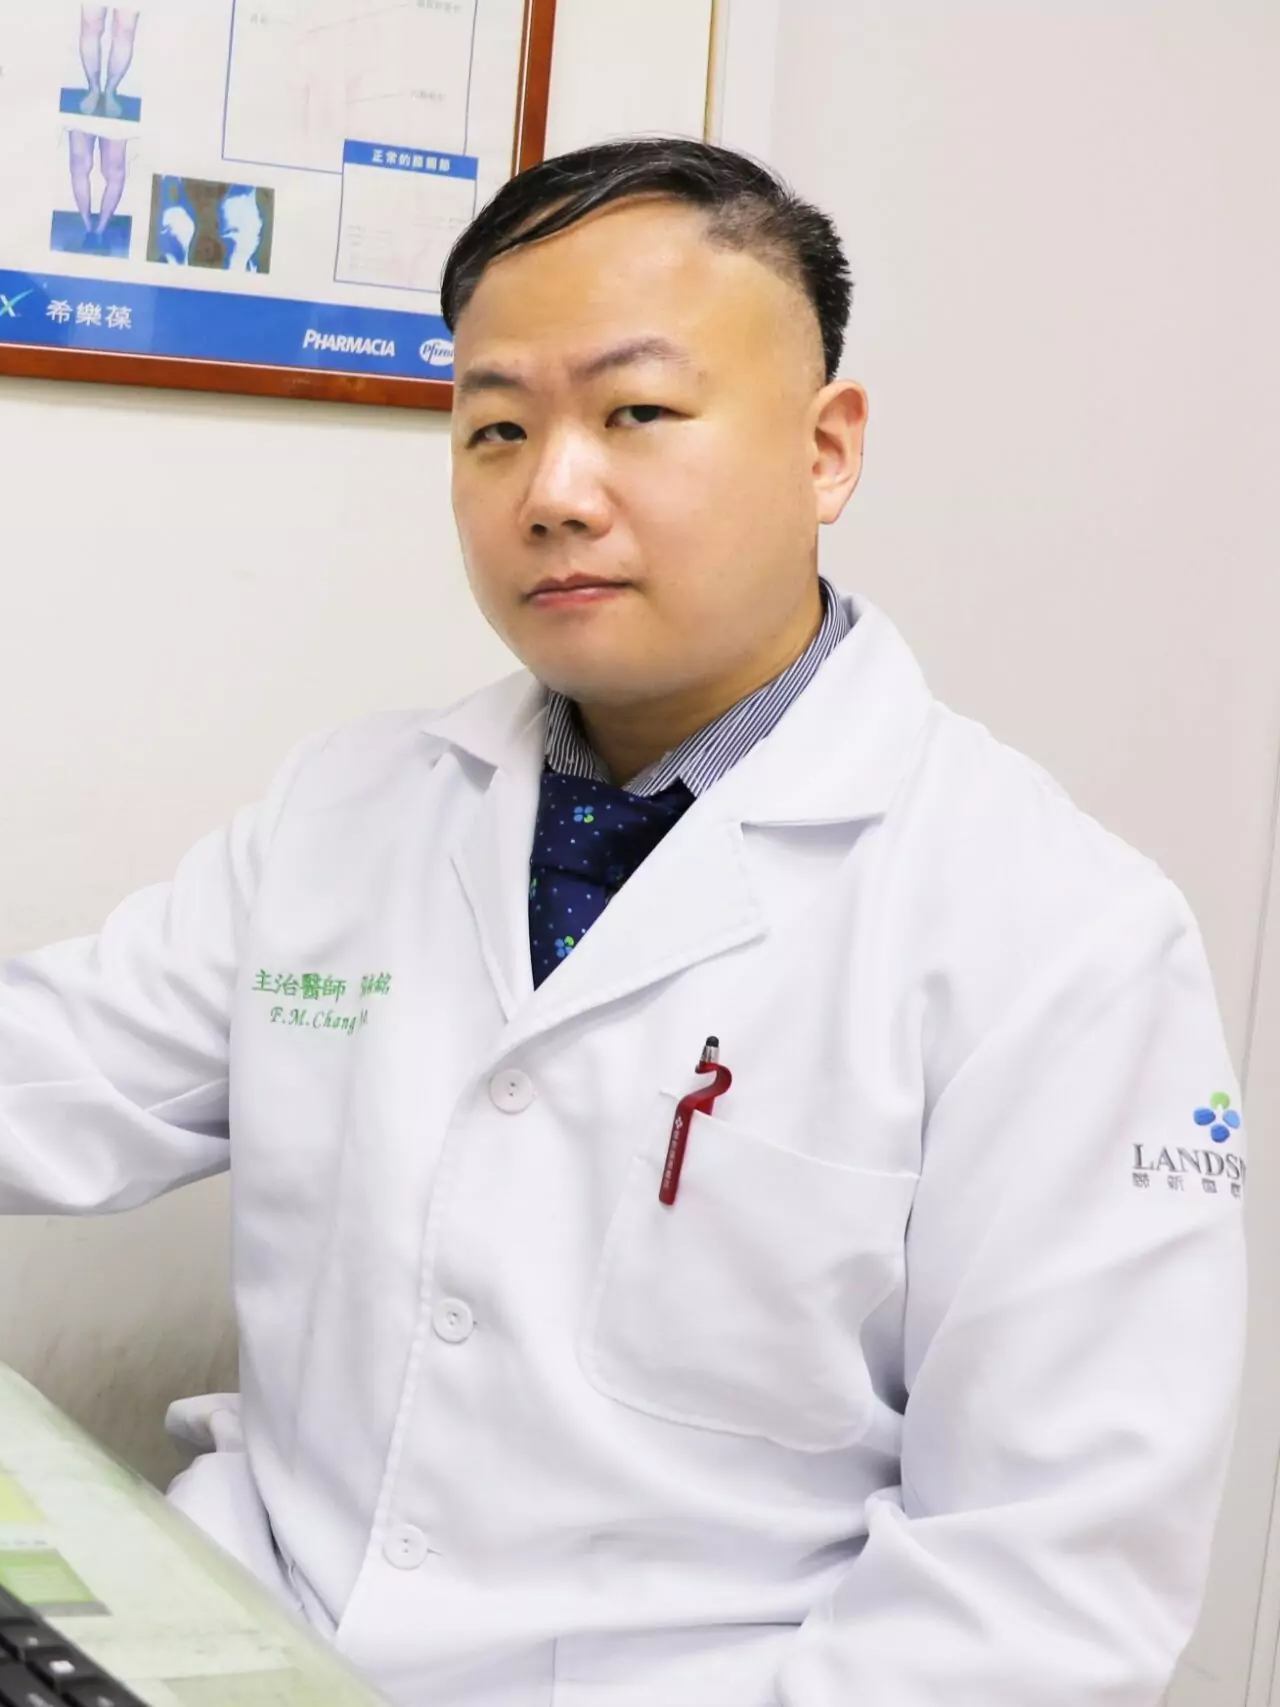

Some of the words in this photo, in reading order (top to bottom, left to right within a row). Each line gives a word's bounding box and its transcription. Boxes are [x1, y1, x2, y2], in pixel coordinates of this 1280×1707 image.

[46, 299, 133, 330] 希樂葆
[303, 329, 396, 357] PHARMACIA
[251, 968, 347, 1005] 主治醫師
